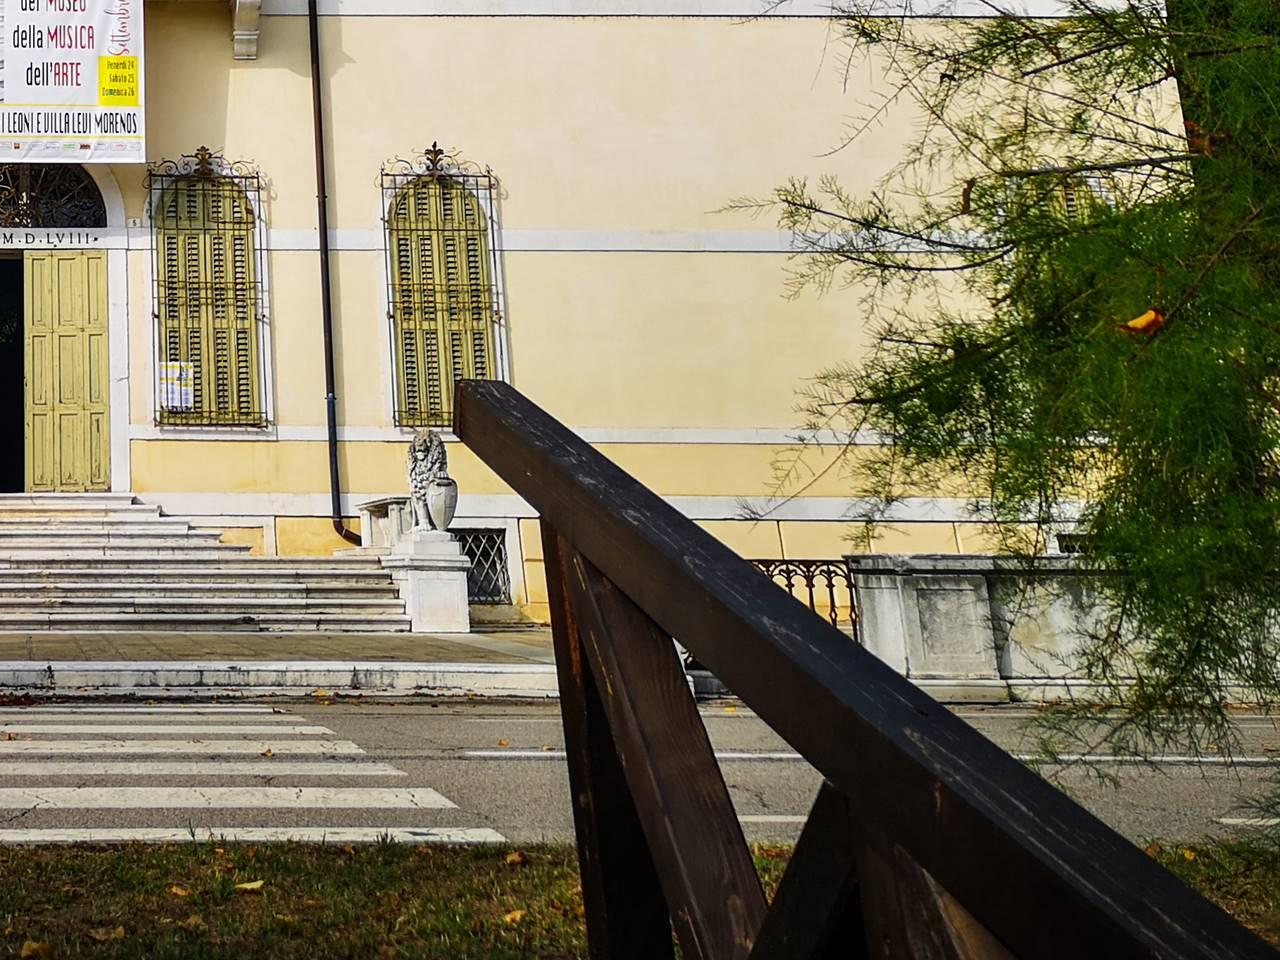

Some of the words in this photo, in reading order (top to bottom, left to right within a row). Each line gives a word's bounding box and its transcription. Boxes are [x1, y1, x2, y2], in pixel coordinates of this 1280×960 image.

[12, 24, 43, 49] della
[47, 24, 95, 49] MUSICA
[8, 112, 34, 133] LEONI
[36, 112, 42, 133] E
[44, 112, 70, 133] VILLA
[95, 112, 137, 133] MORENOS
